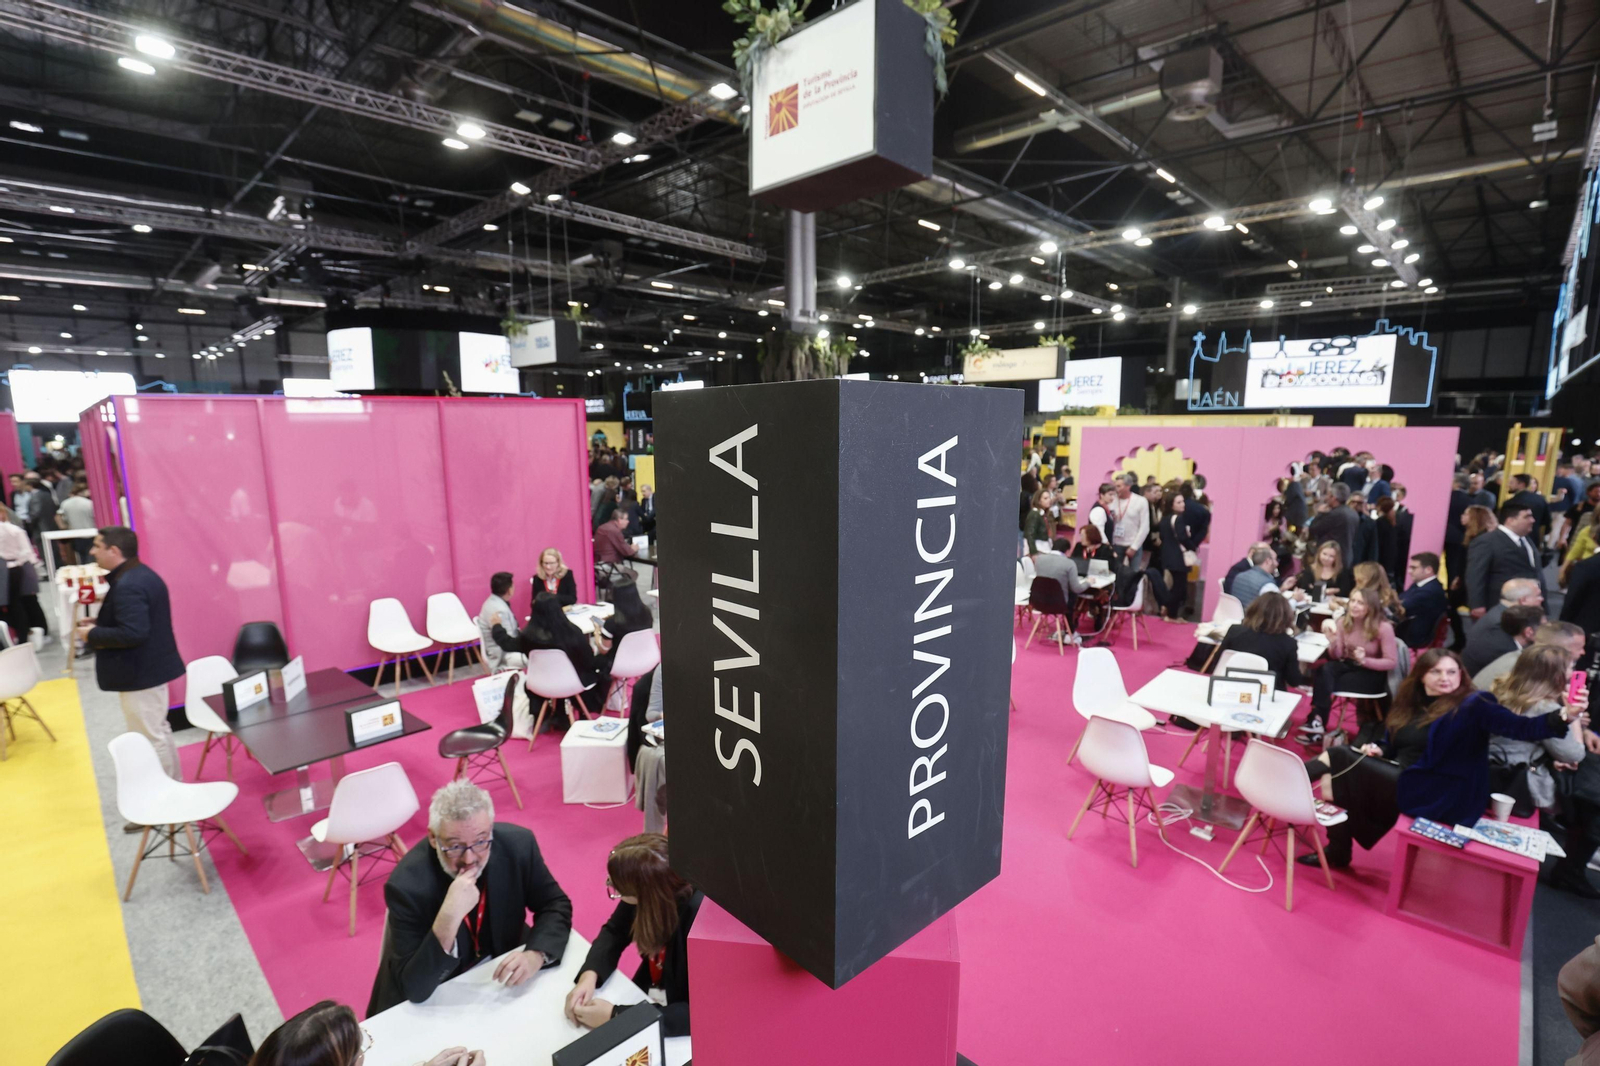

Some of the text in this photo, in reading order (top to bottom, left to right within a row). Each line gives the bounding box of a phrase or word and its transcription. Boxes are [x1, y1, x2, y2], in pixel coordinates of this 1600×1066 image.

[803, 69, 832, 87] Turismo
[823, 69, 858, 91] Provincia
[1306, 359, 1362, 375] JEREZ
[1073, 374, 1104, 388] JEREZ
[1191, 386, 1239, 407] JAÉN
[708, 422, 762, 788] SEVILLA
[907, 434, 959, 841] PROVINCIA
